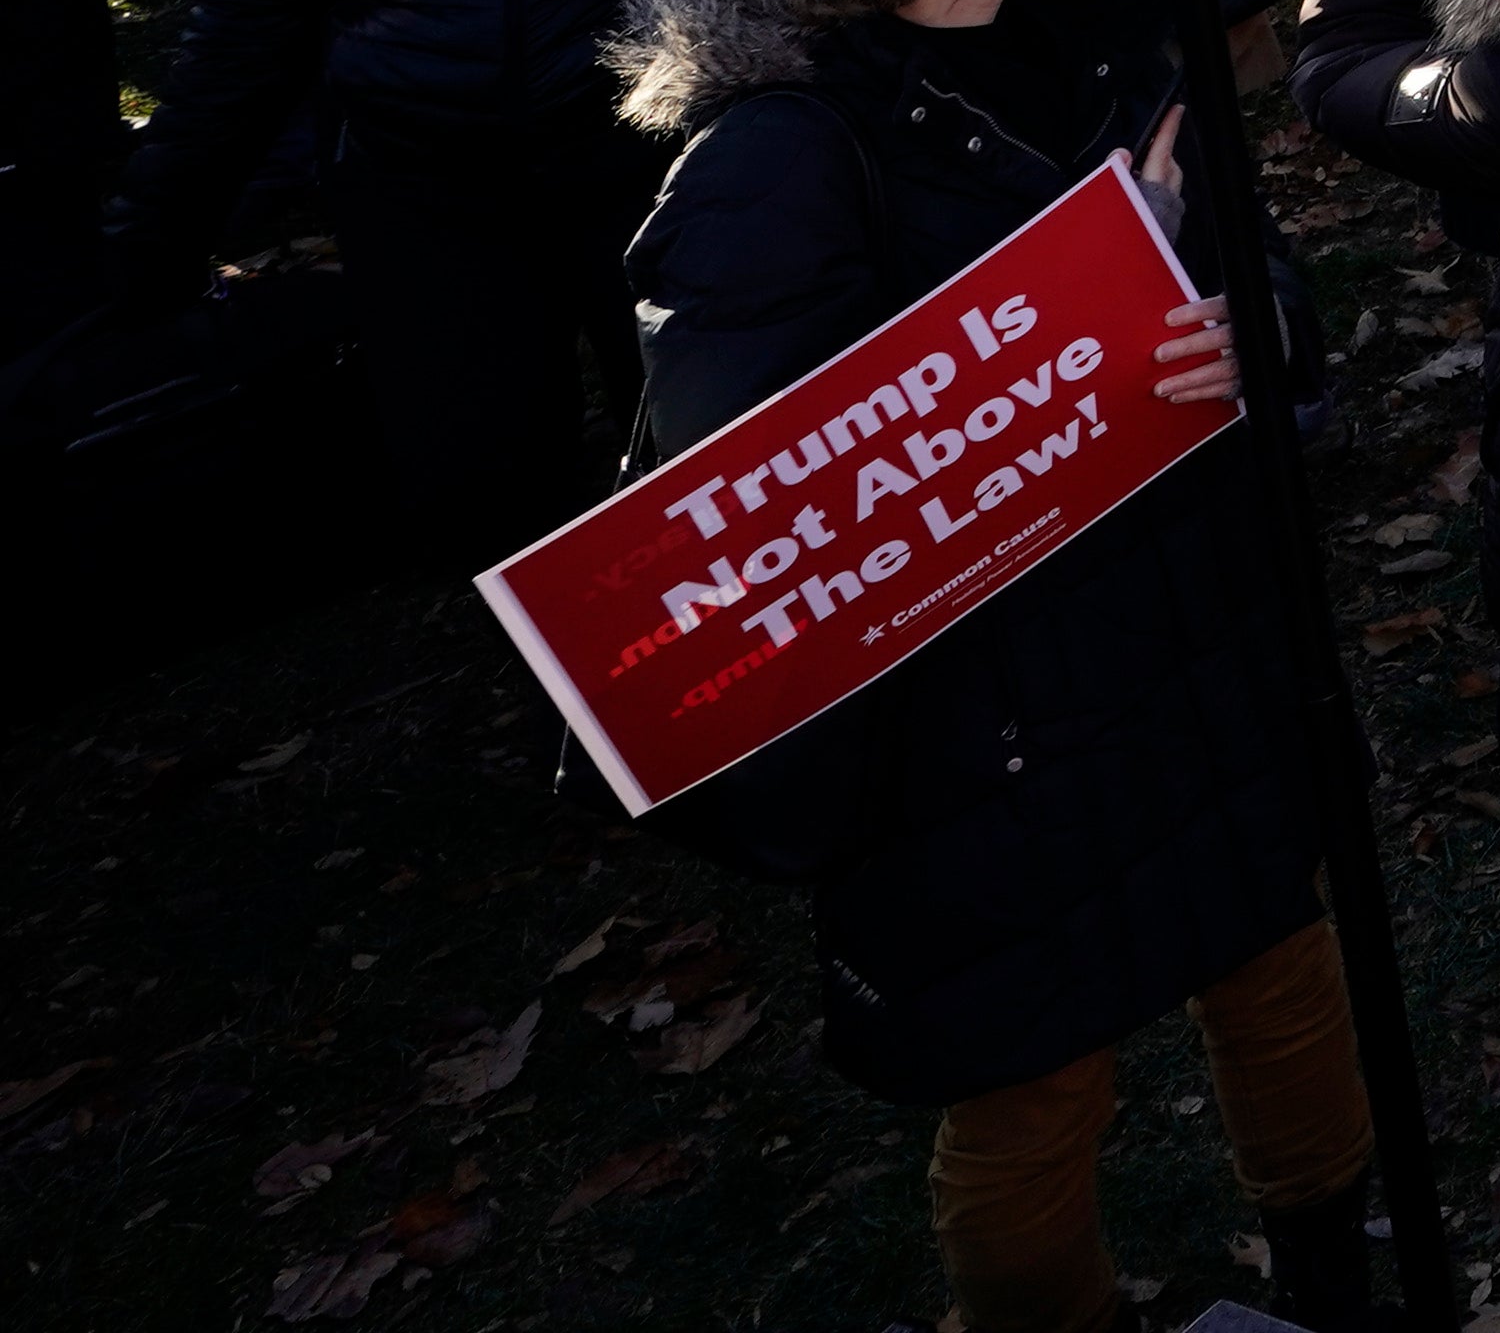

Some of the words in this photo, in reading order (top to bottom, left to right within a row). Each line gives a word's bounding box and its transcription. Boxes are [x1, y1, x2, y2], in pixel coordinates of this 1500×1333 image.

[660, 506, 837, 635] Not
[852, 336, 1104, 522] Above
[665, 348, 958, 541] Trump
[958, 293, 1039, 361] Is
[741, 538, 912, 650] The
[919, 391, 1108, 545] Law!
[891, 555, 993, 627] Common
[994, 506, 1061, 556] Cause
